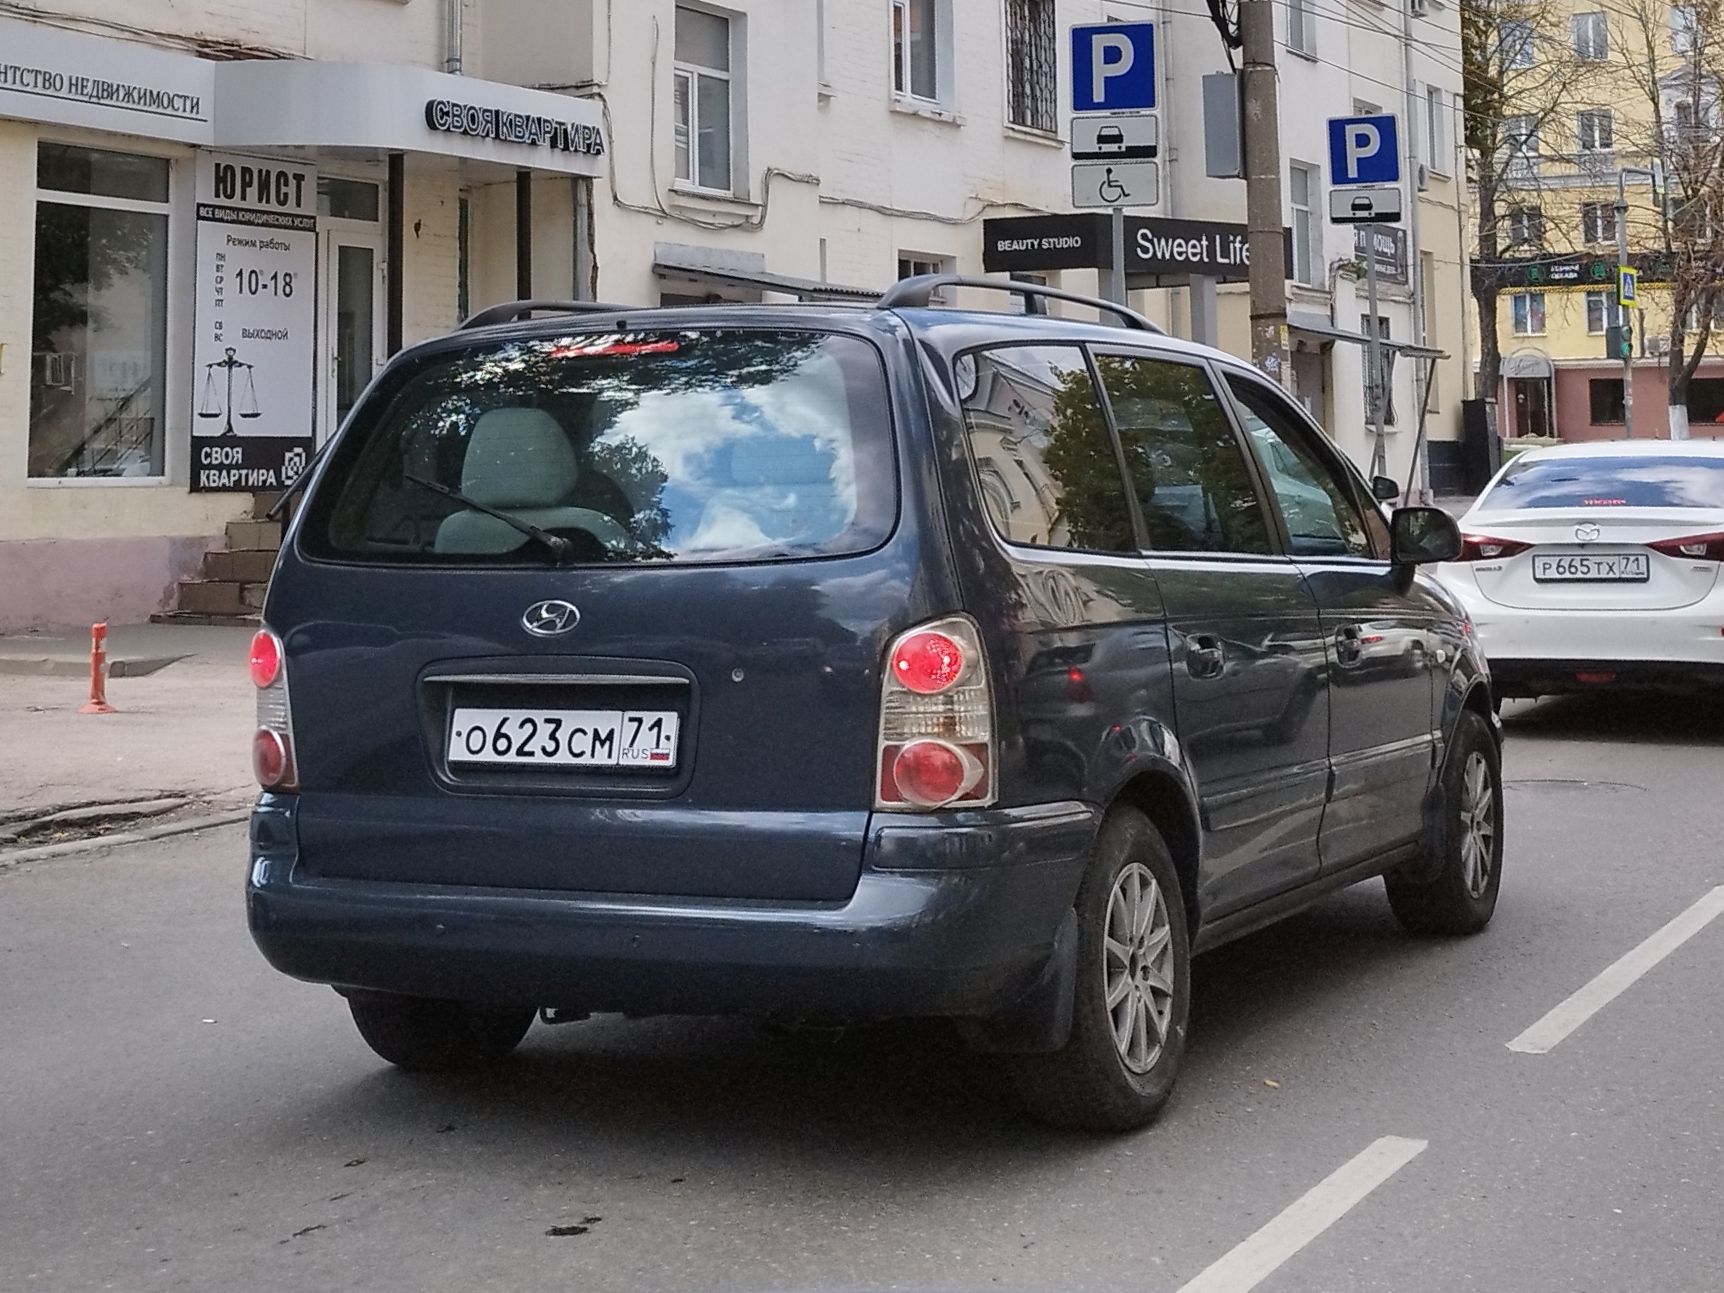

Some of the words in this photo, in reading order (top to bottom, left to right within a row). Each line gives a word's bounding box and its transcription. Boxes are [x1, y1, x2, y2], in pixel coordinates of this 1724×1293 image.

[1092, 33, 1134, 103] P
[68, 75, 201, 115] НЕДВИЖИМОСТИ
[426, 98, 496, 139] СВОЯ
[500, 109, 606, 157] КВАРТИРА
[1345, 123, 1381, 178] P
[214, 162, 305, 208] ЮРИСТ
[199, 206, 213, 218] ВСЕ
[214, 208, 238, 221] ВИДЫ
[238, 211, 293, 226] ЮРИДИЧЕСКИХ
[226, 234, 257, 248] Режим
[259, 237, 291, 251] работы
[997, 238, 1039, 251] BEAUTY
[1041, 236, 1082, 249] STUDIO
[1136, 228, 1209, 262] Sweet
[200, 446, 243, 465] СВОЯ
[199, 468, 277, 487] КВАРТИРА
[1622, 556, 1640, 571] 71
[627, 716, 664, 749] 71
[622, 747, 649, 760] RUS
